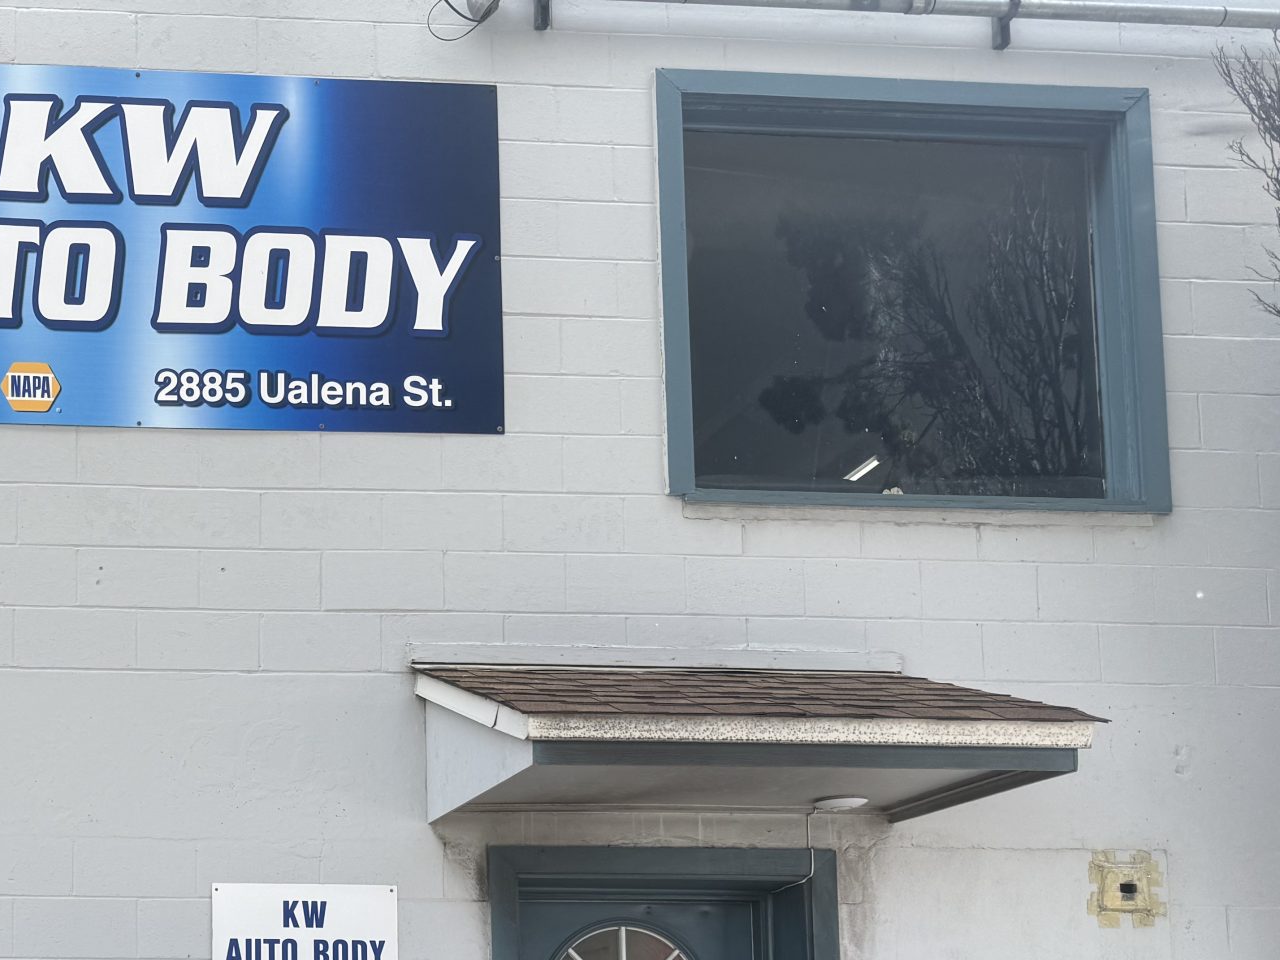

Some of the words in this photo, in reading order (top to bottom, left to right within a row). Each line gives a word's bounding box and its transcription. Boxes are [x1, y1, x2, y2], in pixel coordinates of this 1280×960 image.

[154, 228, 479, 333] BODY
[10, 375, 51, 399] NAPA
[155, 370, 246, 403] 2885
[259, 372, 391, 407] Ualena
[402, 374, 453, 407] St.
[282, 900, 328, 929] KW
